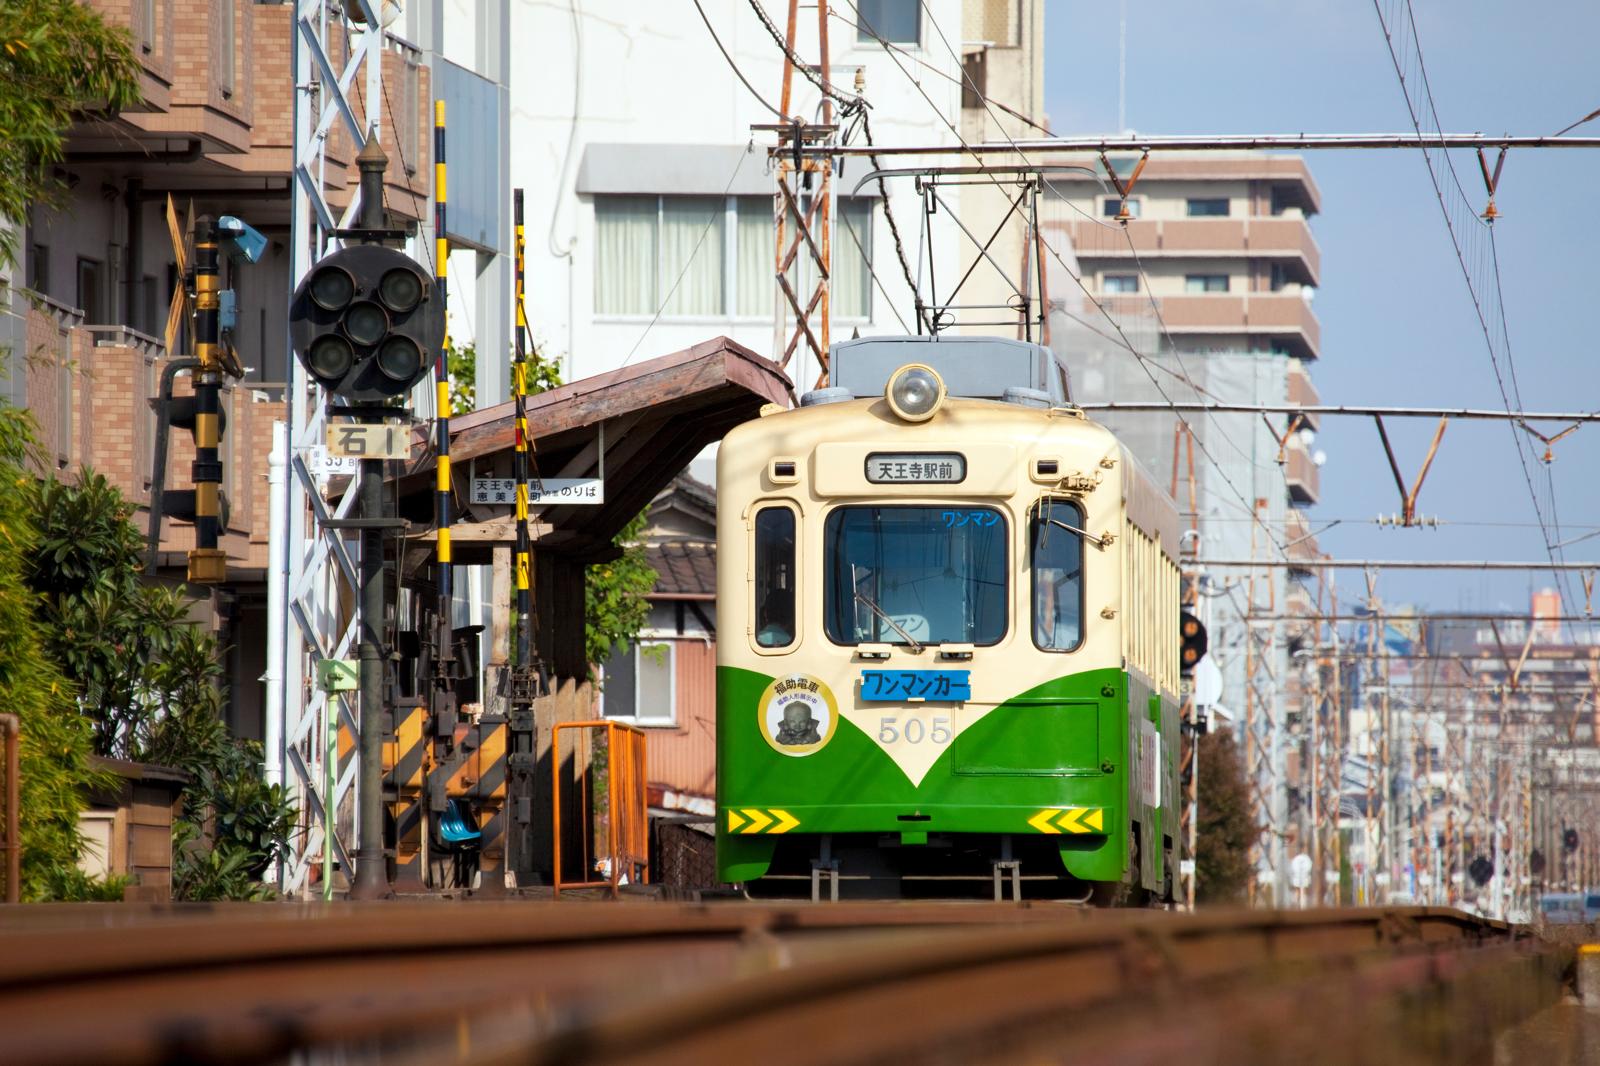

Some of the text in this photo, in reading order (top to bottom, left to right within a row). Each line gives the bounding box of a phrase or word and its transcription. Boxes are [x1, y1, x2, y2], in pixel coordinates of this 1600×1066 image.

[338, 427, 368, 456] 石
[878, 462, 953, 480] 天王寺駅前
[476, 480, 541, 491] 天王寺前
[561, 486, 597, 498] のりば
[476, 492, 541, 502] 恵美町
[942, 511, 1000, 528] ワンマン
[774, 677, 820, 696] 福助電車
[864, 672, 968, 697] ワンマンカー
[878, 717, 952, 745] 505
